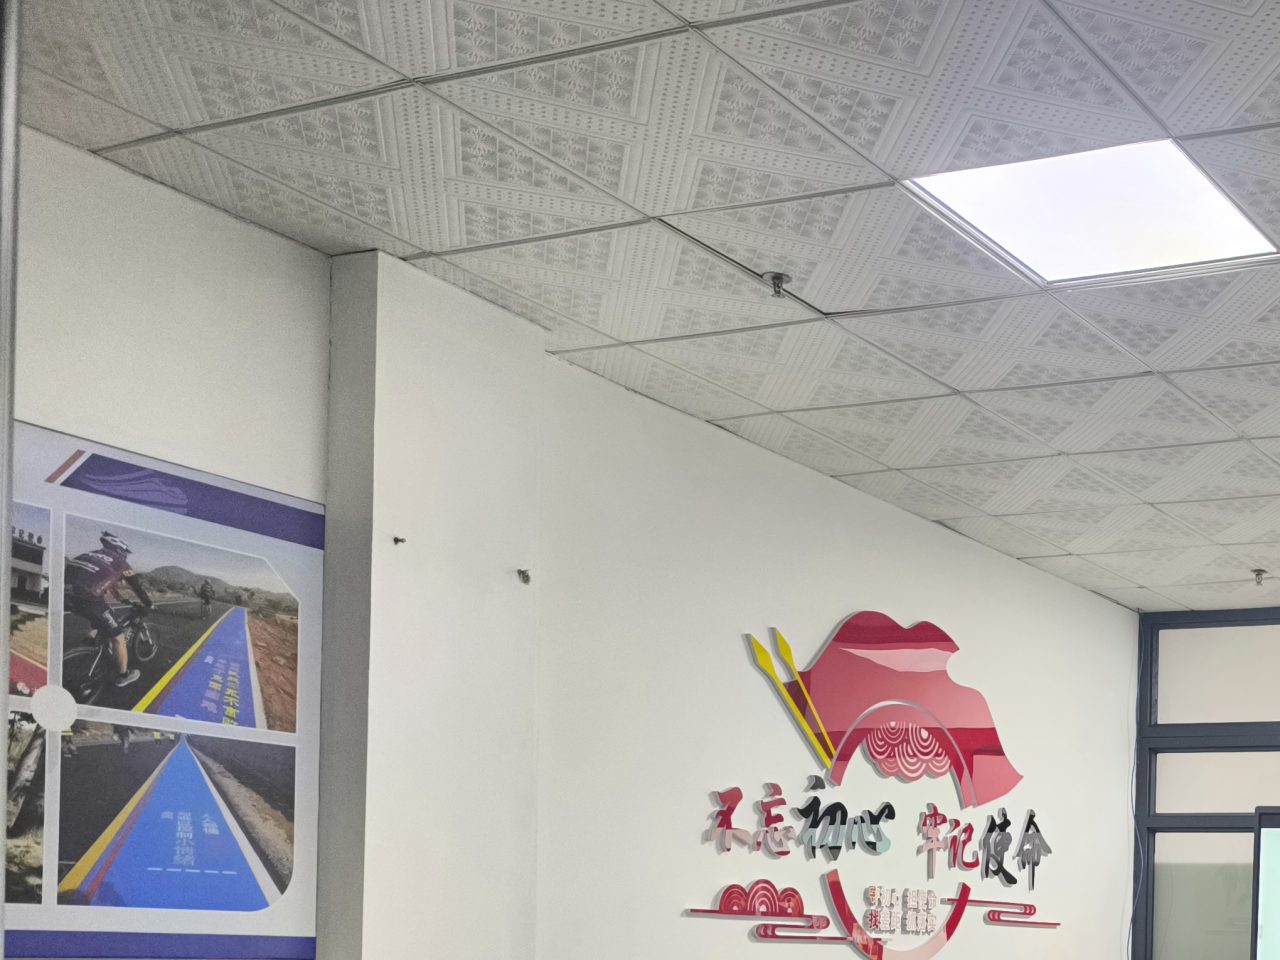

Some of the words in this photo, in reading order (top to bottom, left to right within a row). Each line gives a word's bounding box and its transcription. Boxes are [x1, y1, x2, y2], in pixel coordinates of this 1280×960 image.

[703, 775, 896, 861] 不忘初心
[917, 803, 1053, 891] 牢记使命
